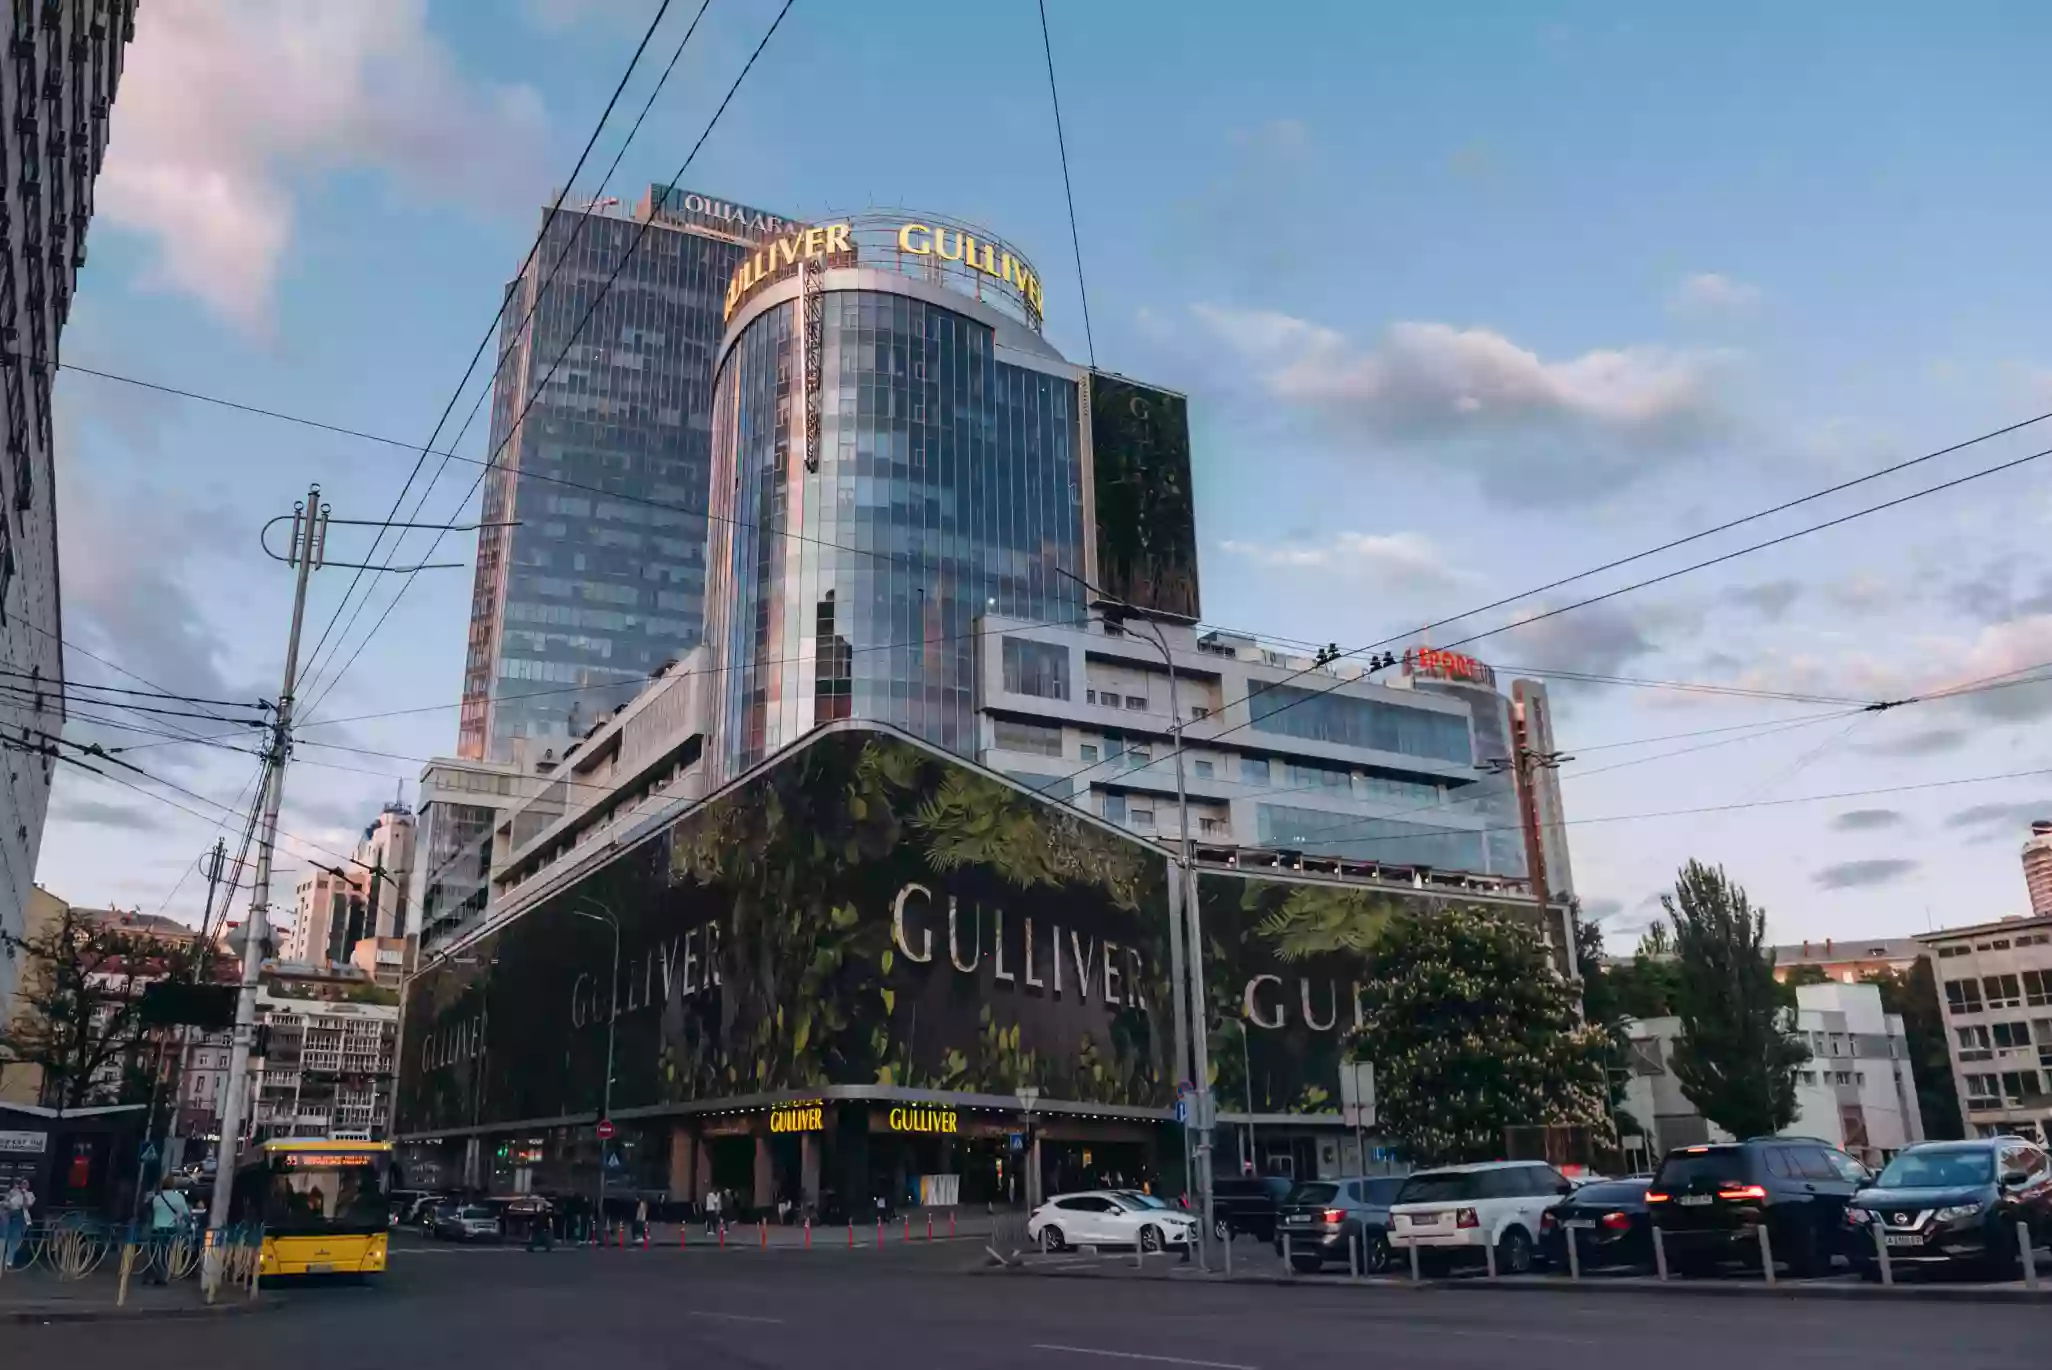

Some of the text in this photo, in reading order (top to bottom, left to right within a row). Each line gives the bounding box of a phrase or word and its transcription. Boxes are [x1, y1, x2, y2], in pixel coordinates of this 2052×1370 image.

[723, 223, 853, 322] GULLIVER
[893, 882, 1148, 1011] GULLIVER
[770, 1107, 825, 1133] GULLIVER
[889, 1107, 958, 1134] GULLIVER
